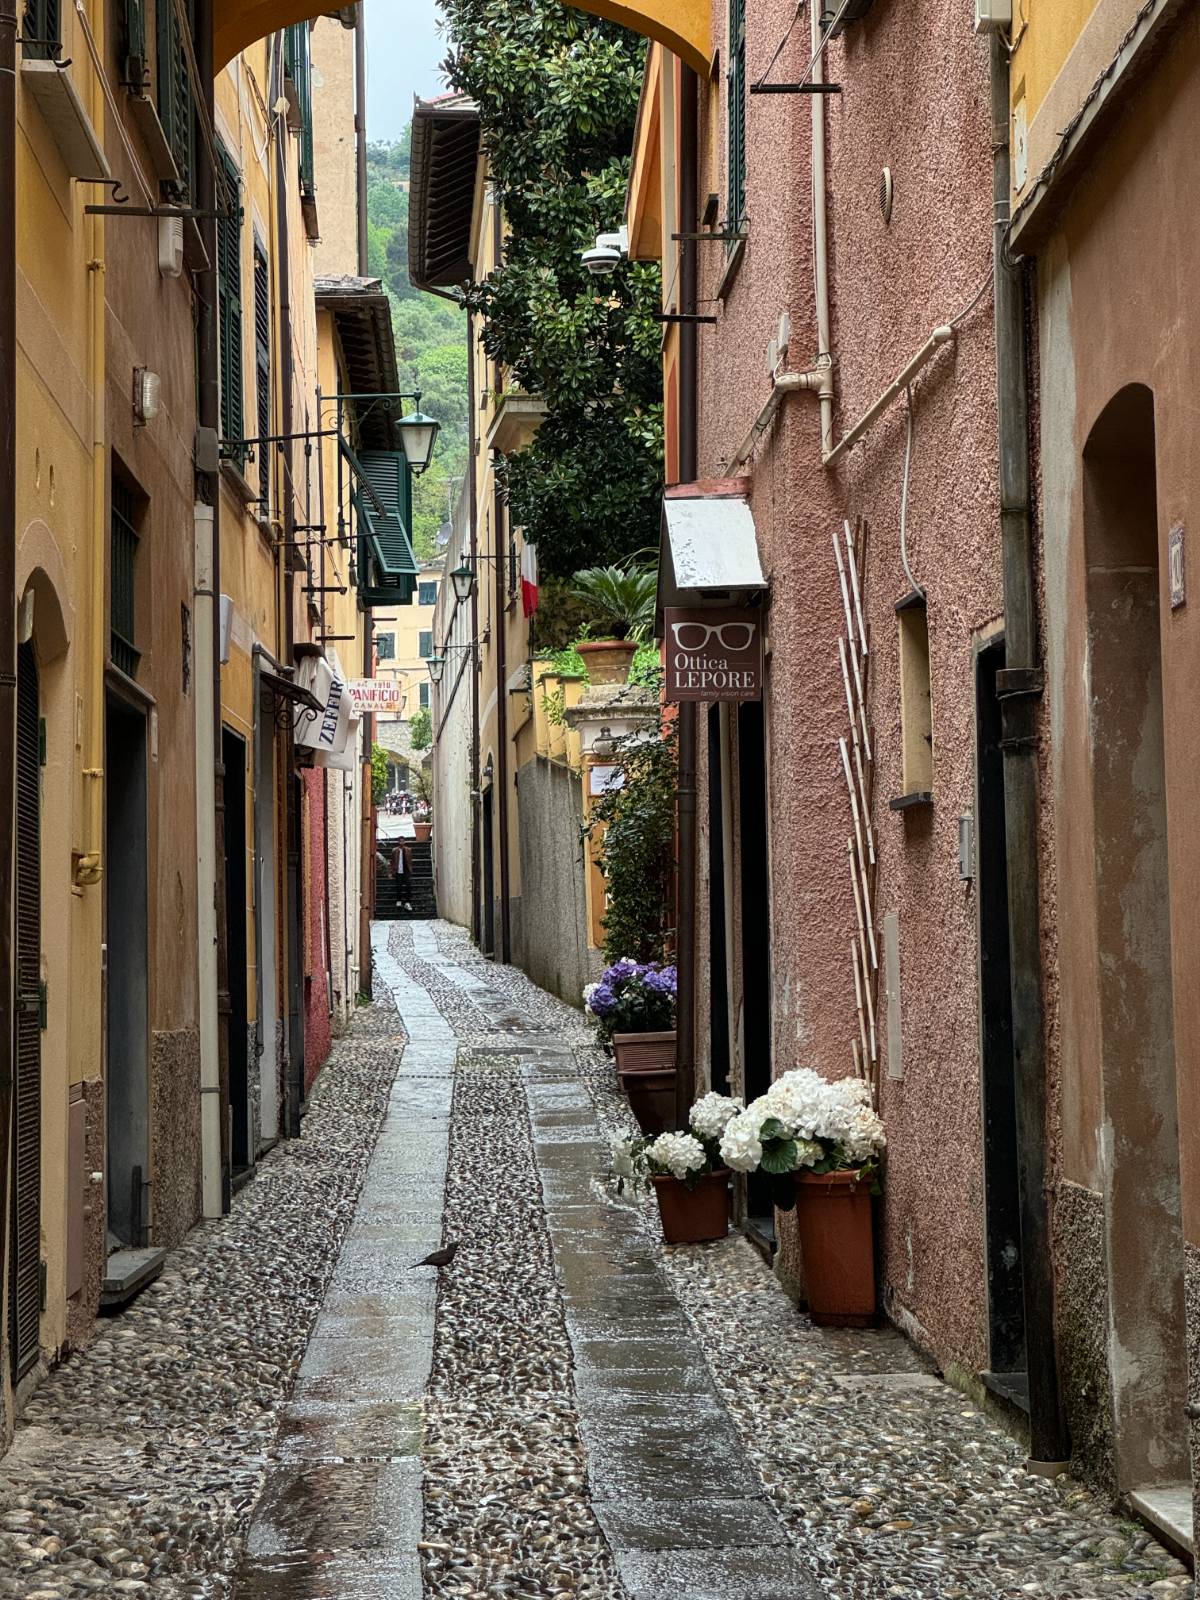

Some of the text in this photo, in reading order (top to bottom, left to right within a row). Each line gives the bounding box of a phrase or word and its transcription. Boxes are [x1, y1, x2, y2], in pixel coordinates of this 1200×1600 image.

[674, 652, 728, 670] Ottica
[674, 671, 755, 688] LEPORE
[349, 689, 399, 702] PANIFICIO
[700, 690, 720, 698] family
